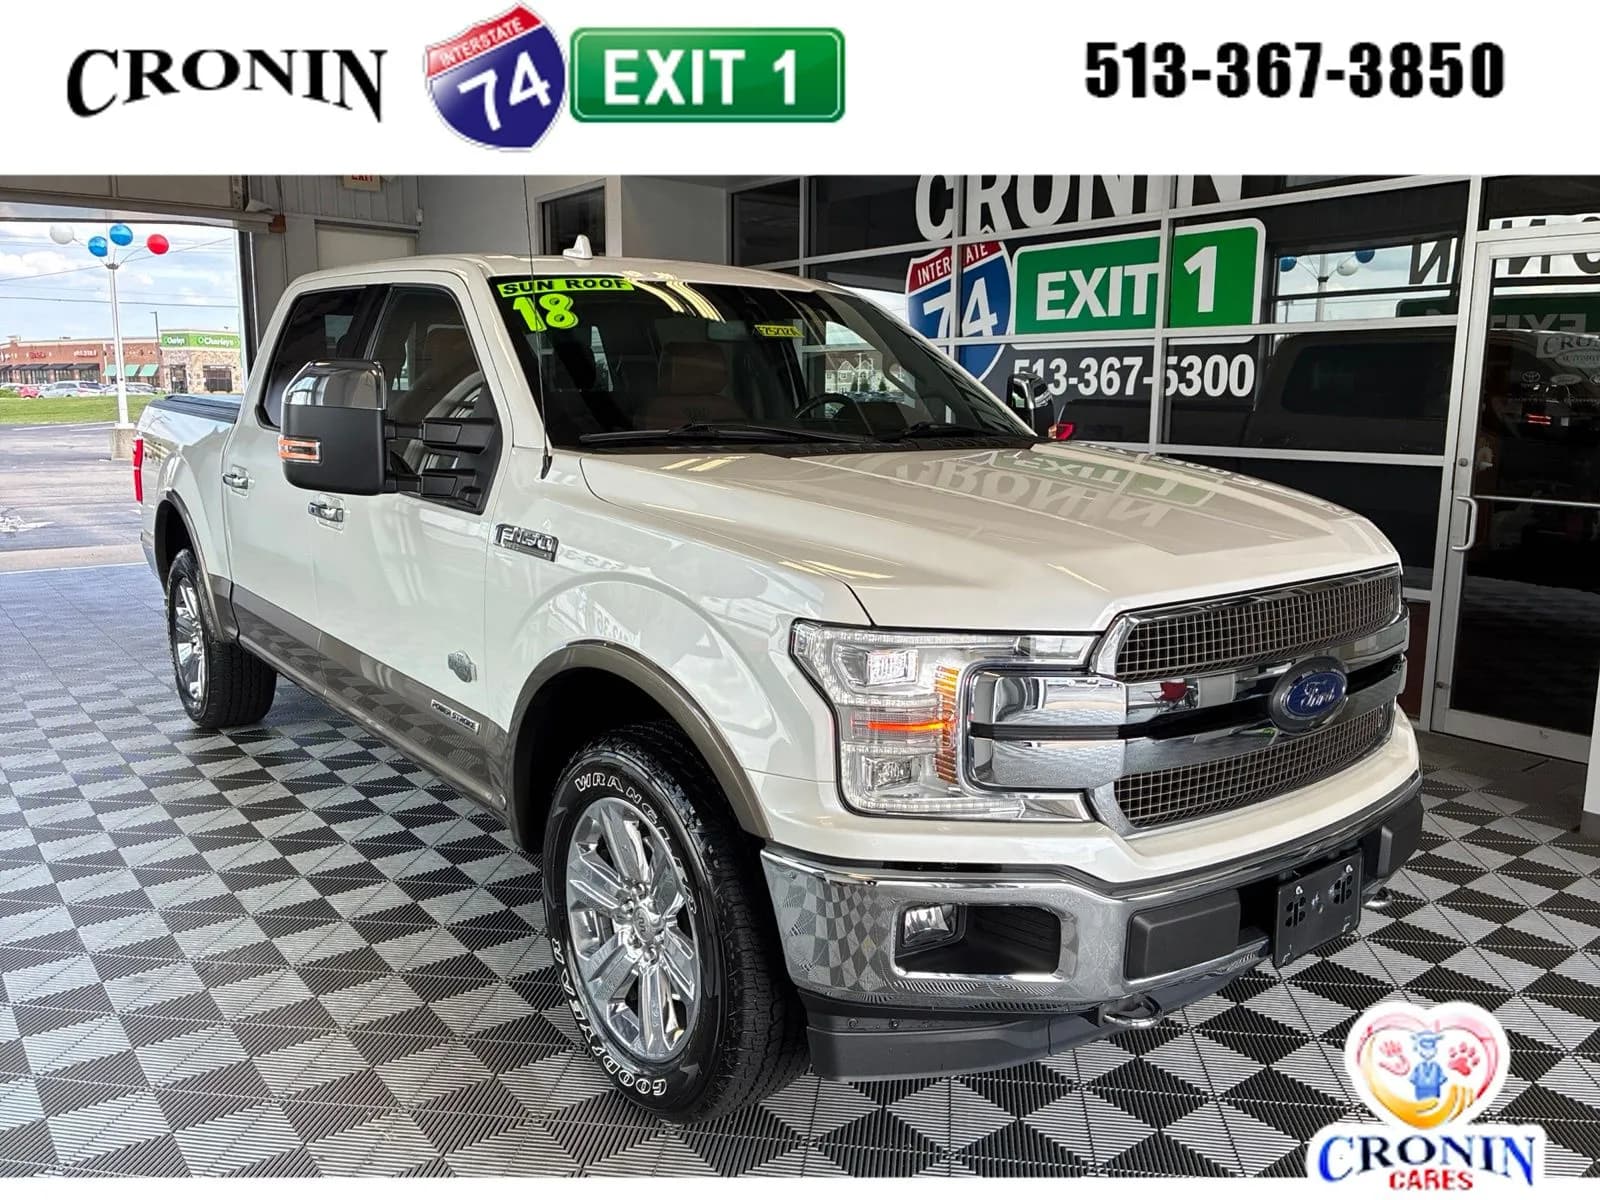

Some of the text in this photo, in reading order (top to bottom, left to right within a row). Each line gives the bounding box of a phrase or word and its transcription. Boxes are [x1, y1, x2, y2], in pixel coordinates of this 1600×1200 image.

[917, 242, 989, 286] INTERATE
[1036, 246, 1218, 321] EXIT 1
[503, 278, 628, 295] SUN ROOF
[922, 277, 998, 337] 74
[513, 293, 579, 332] 18
[1300, 681, 1337, 708] Ford
[551, 937, 667, 1096] GOODYEAR
